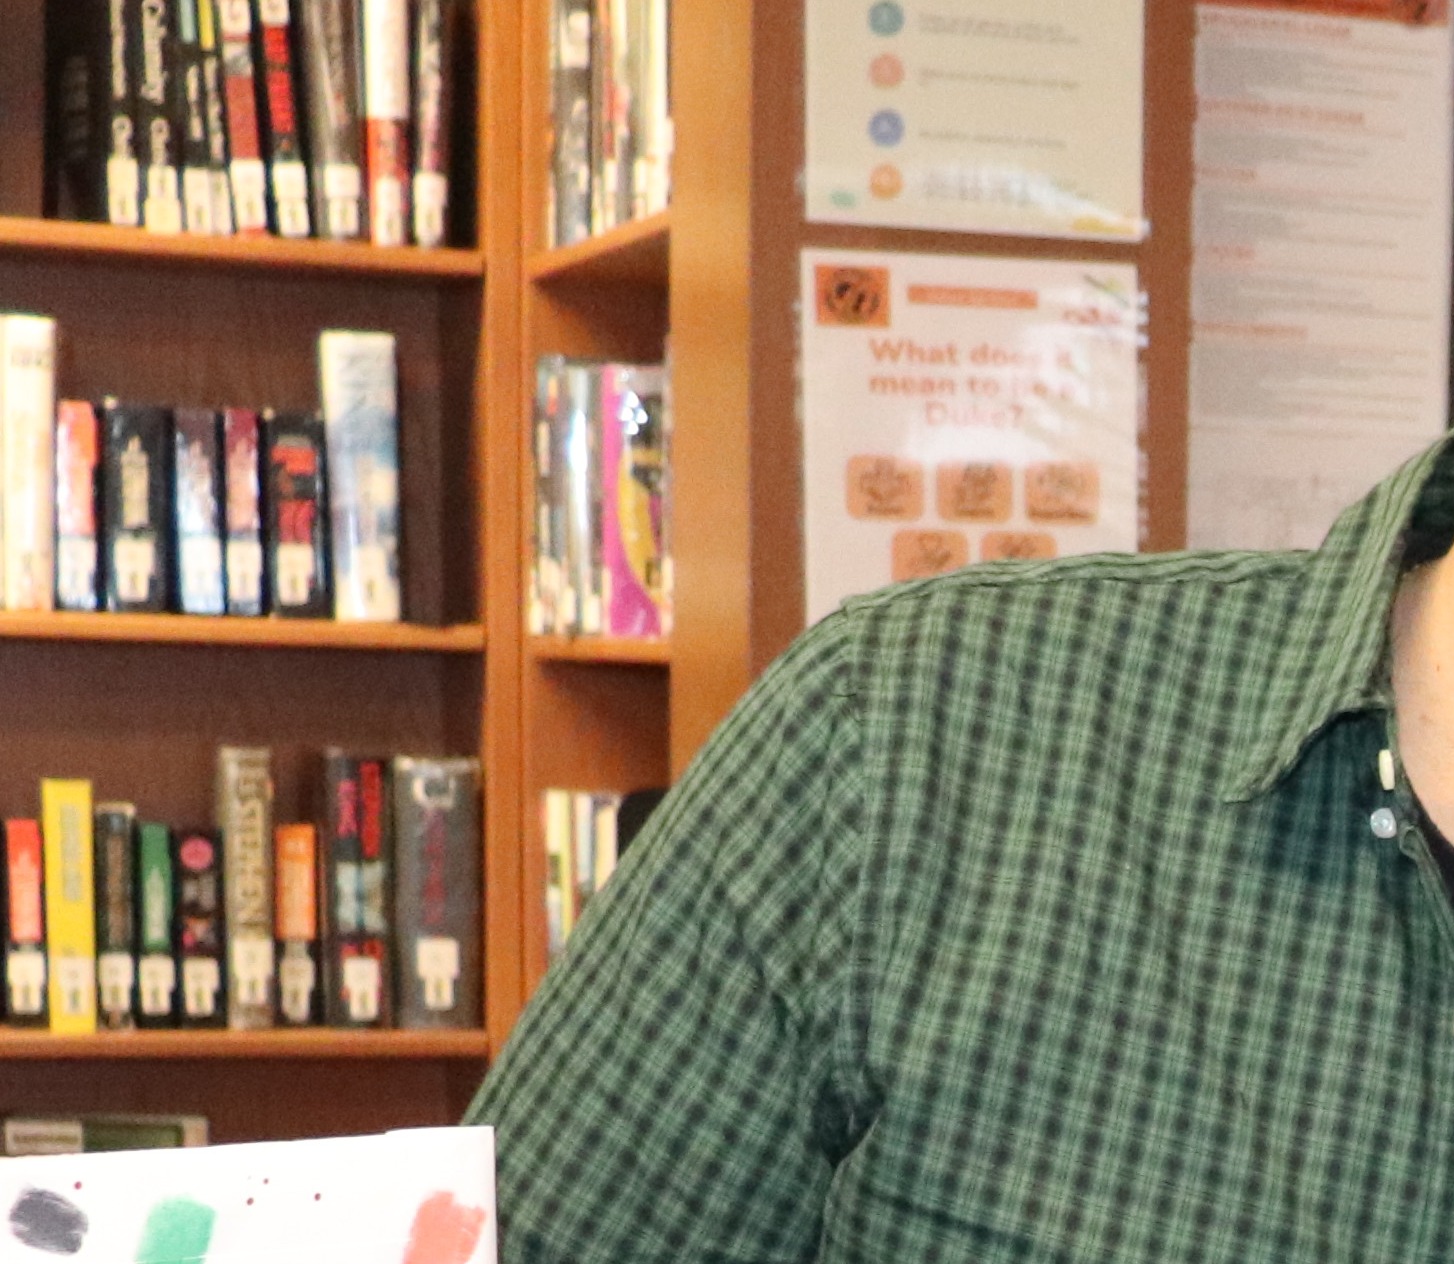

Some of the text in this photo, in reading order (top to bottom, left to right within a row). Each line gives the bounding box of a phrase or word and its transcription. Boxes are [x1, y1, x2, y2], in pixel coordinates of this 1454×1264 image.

[869, 338, 958, 366] What
[868, 375, 957, 396] mean
[966, 375, 1000, 398] to
